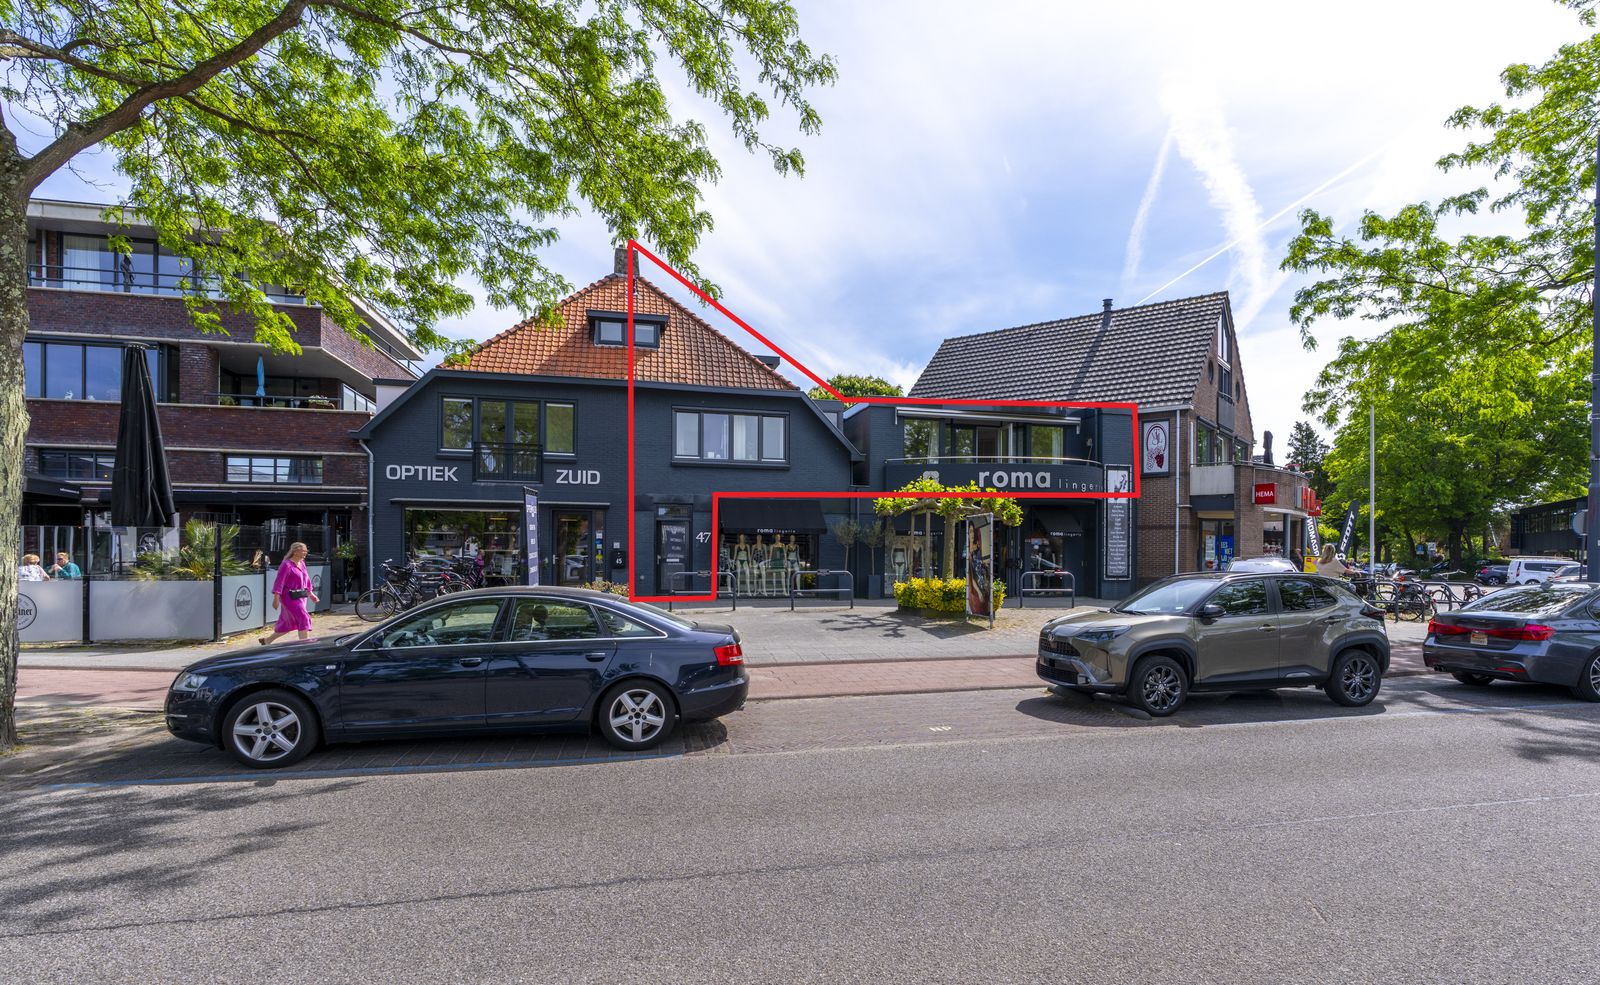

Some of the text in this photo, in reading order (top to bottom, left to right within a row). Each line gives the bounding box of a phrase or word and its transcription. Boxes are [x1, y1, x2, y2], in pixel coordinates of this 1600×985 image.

[385, 464, 601, 485] OPTIEK ZUID
[978, 470, 1051, 488] roma
[1255, 490, 1274, 498] HEMA
[695, 531, 712, 543] 47
[1340, 511, 1355, 552] SCOTT
